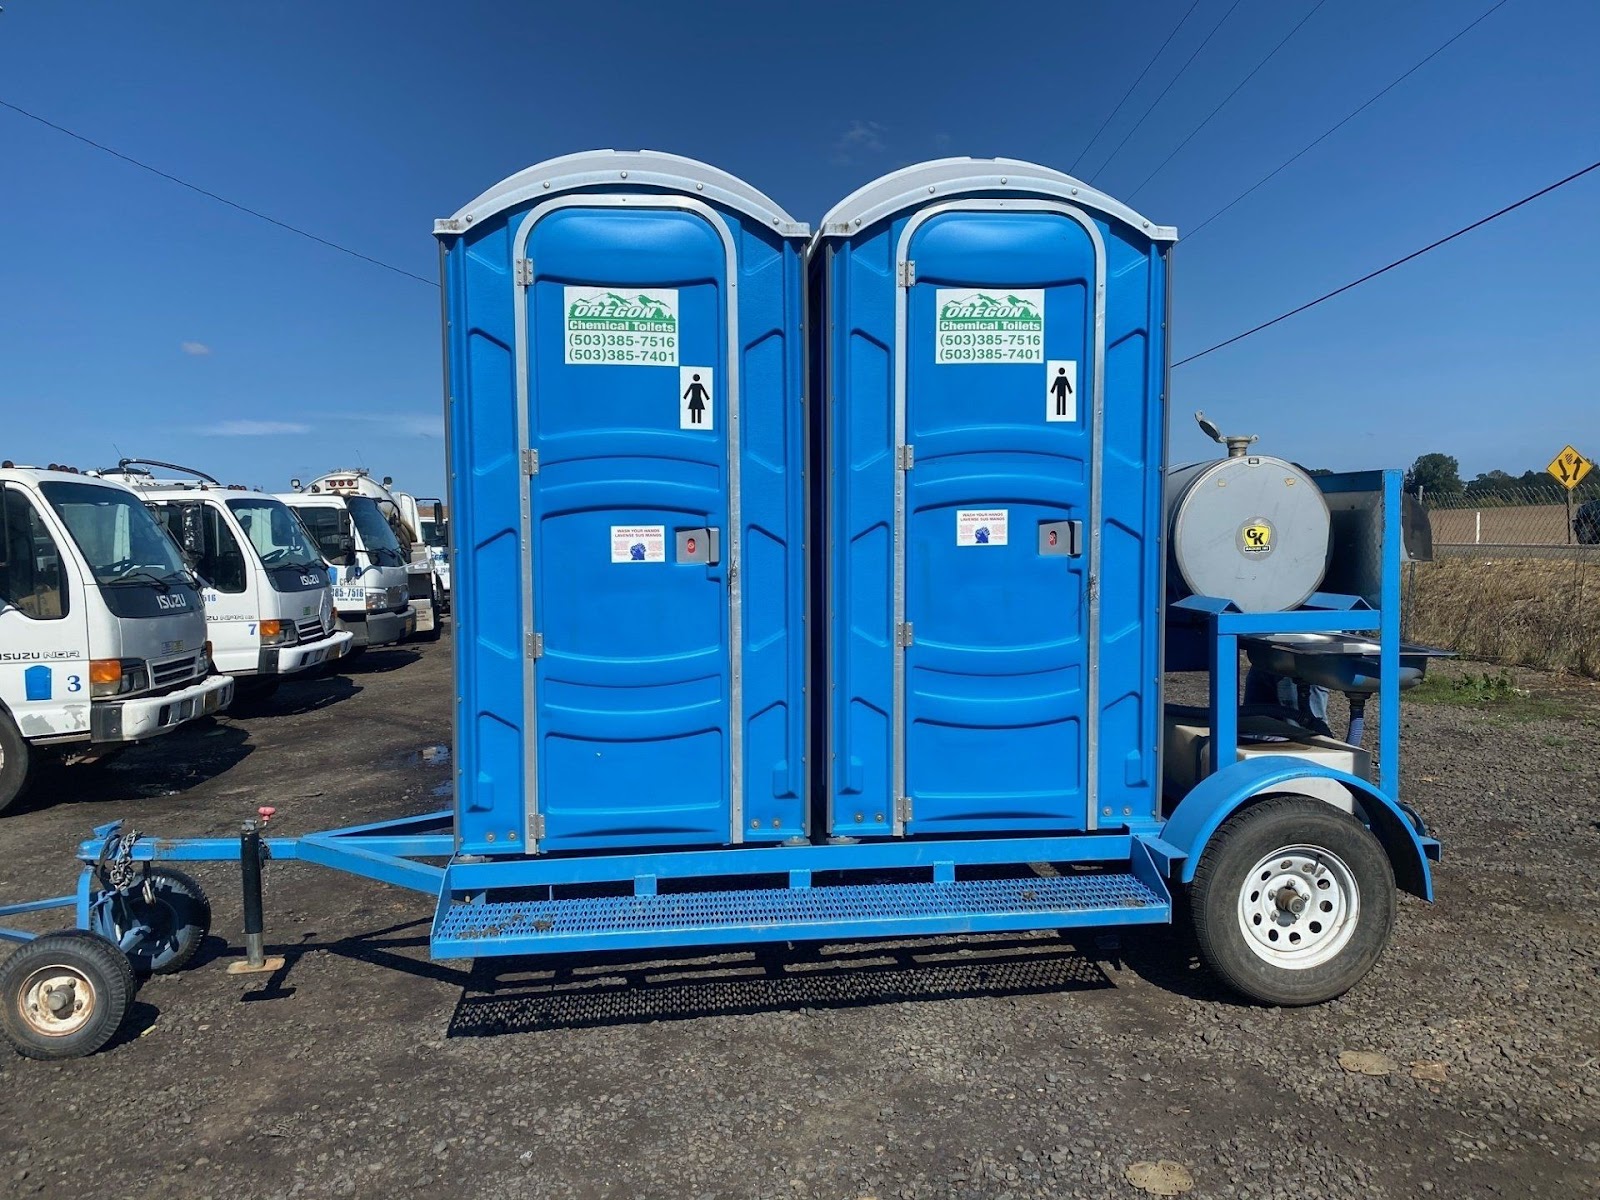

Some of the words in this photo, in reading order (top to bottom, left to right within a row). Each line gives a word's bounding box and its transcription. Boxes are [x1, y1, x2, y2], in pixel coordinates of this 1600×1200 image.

[574, 305, 657, 318] OREGON
[945, 306, 1025, 318] OREGON
[569, 320, 629, 331] Chemical
[632, 321, 675, 333] Toilets
[940, 321, 998, 331] Chemical
[1001, 321, 1041, 331] Toilets
[569, 333, 675, 348] (503)385-7516
[940, 334, 1041, 347] (503)385-7516
[569, 349, 675, 362] (503)385-7401
[940, 348, 1041, 361] (503)385-7401
[300, 574, 320, 586] ISUZU
[156, 593, 186, 609] ISUZU
[248, 623, 257, 636] 7
[0, 652, 40, 660] ISUZU
[67, 675, 82, 692] 3
